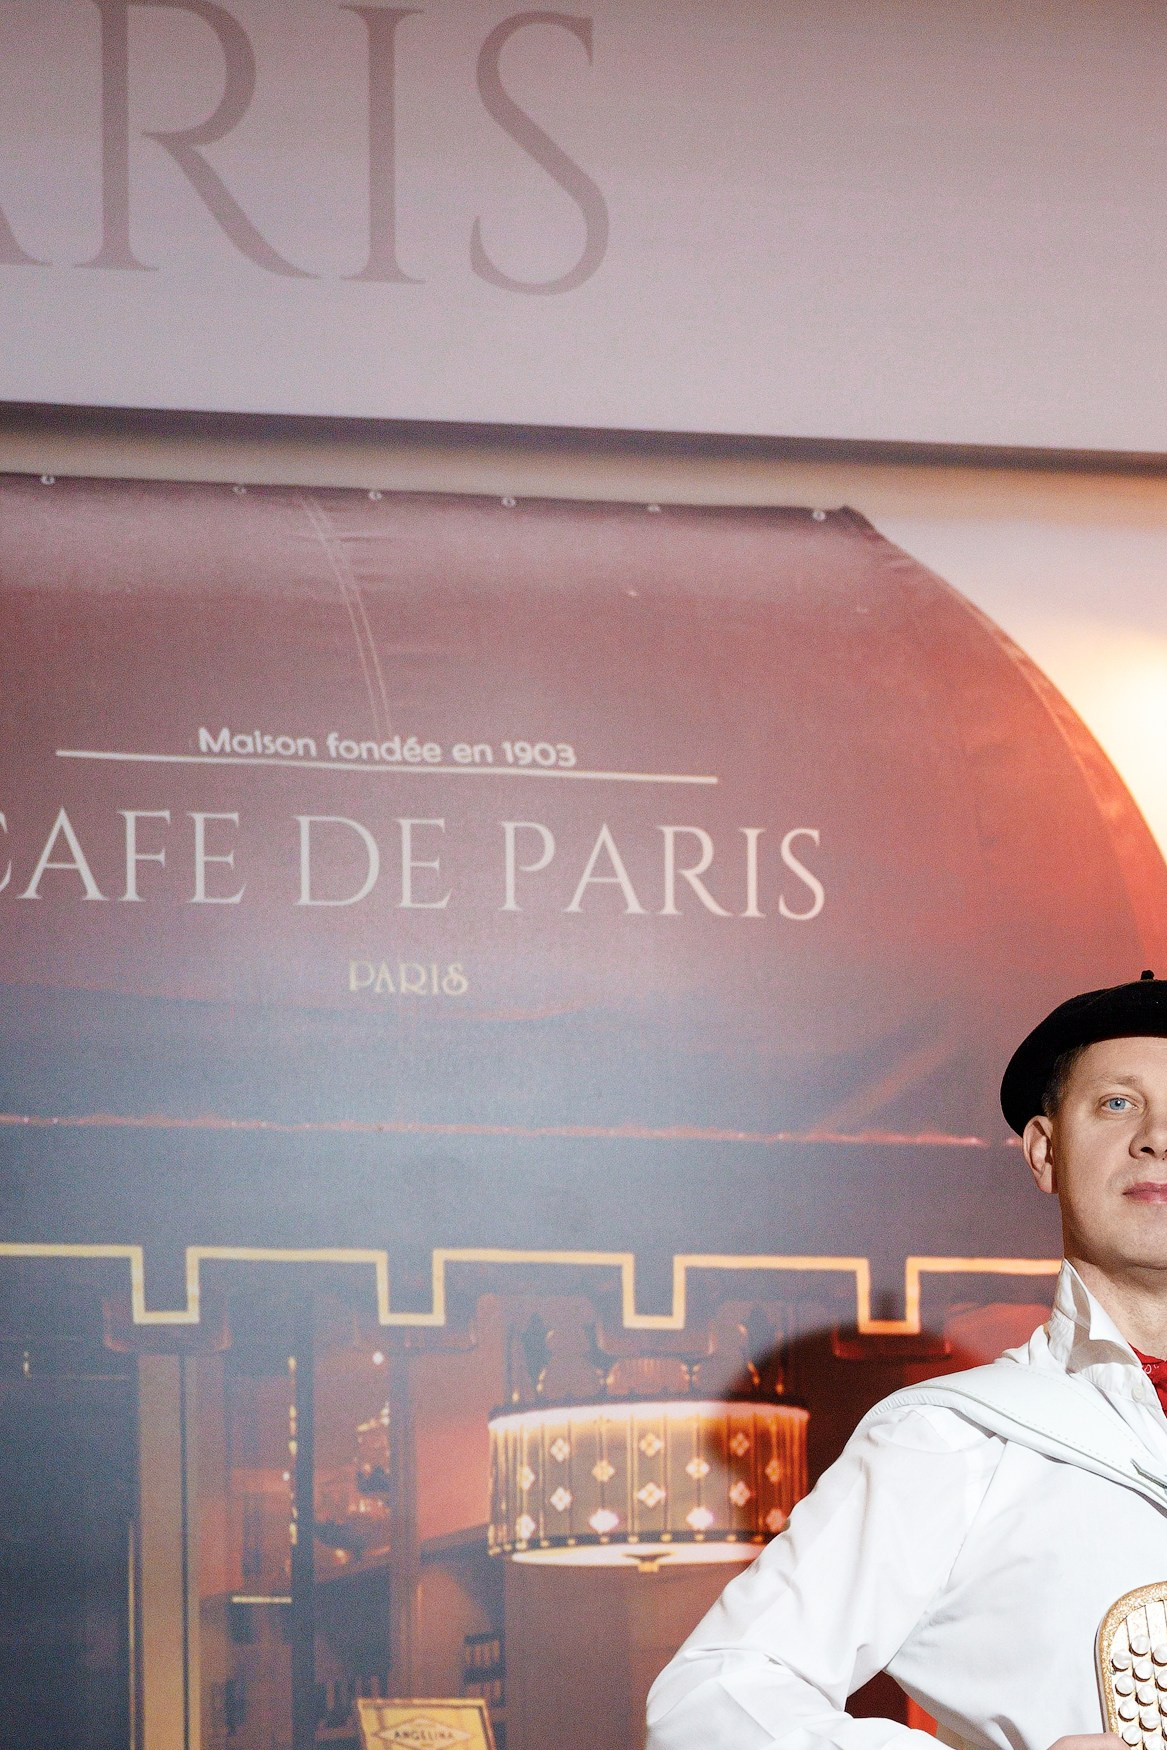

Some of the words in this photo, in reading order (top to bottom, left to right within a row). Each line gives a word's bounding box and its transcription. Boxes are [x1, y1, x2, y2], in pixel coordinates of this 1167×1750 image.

[0, 0, 609, 296] RIS
[198, 727, 318, 756] Maison
[326, 732, 443, 764] fondée
[452, 742, 494, 764] en
[502, 741, 578, 767] 1903
[0, 805, 247, 905] AFE
[295, 813, 453, 910] DE
[500, 820, 826, 921] PARIS
[348, 958, 470, 997] PARIS
